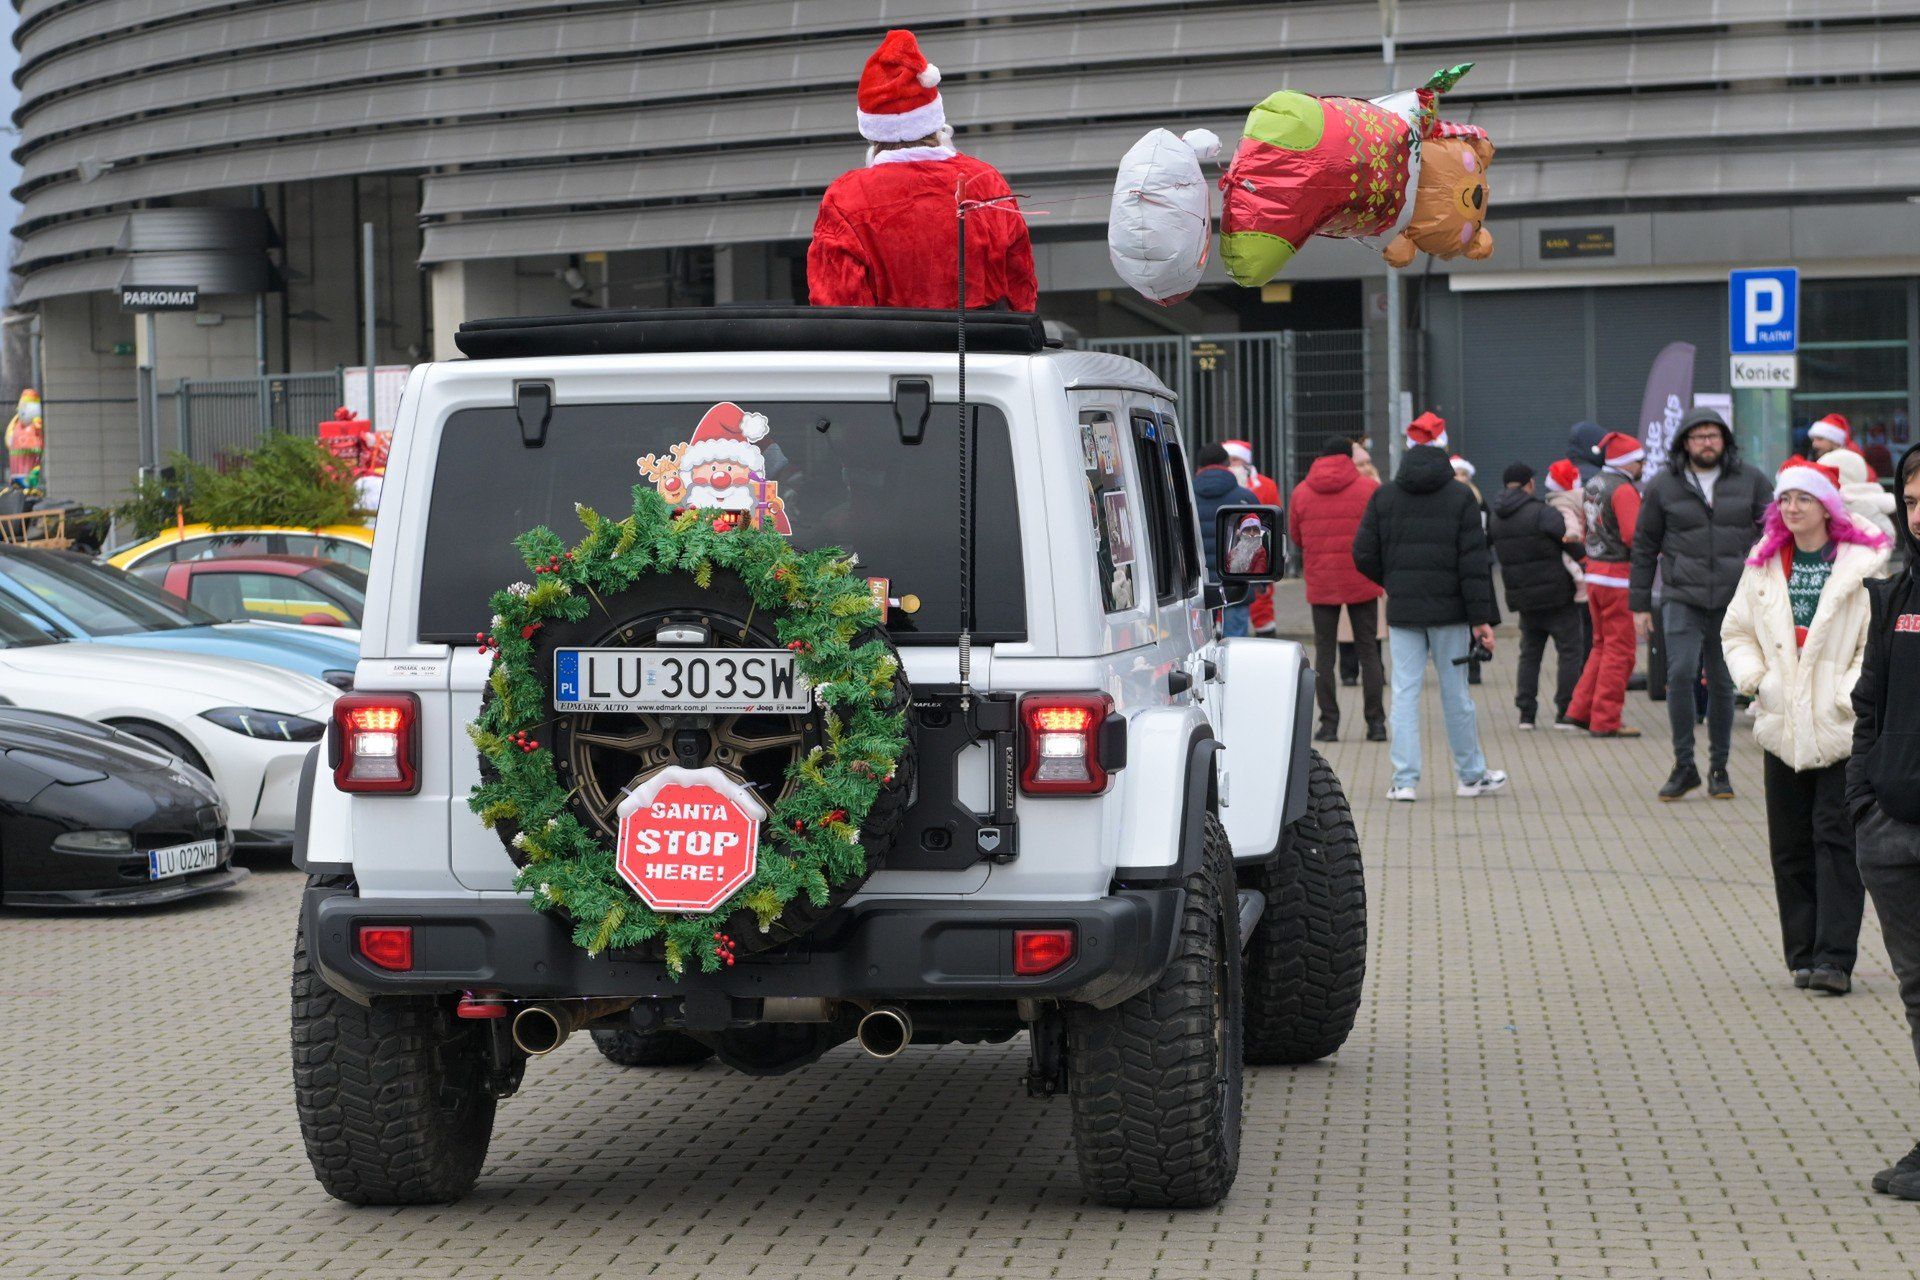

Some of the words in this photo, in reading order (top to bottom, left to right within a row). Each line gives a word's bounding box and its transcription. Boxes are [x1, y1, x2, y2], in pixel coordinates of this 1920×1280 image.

[123, 291, 196, 305] PARKOMAT
[1745, 278, 1784, 344] P
[1734, 362, 1790, 381] Koniec
[589, 657, 641, 698] LU
[661, 657, 795, 699] 303SW
[561, 683, 576, 694] PL
[560, 703, 600, 711] EDMARK
[603, 703, 629, 711] AUTO
[637, 703, 708, 712] www.edmark.com.pl
[756, 704, 774, 712] Jeep
[651, 802, 728, 821] SANTA
[635, 829, 740, 857] STOP
[159, 850, 175, 875] LU
[179, 843, 215, 871] 022MH
[645, 863, 725, 881] HERE!
